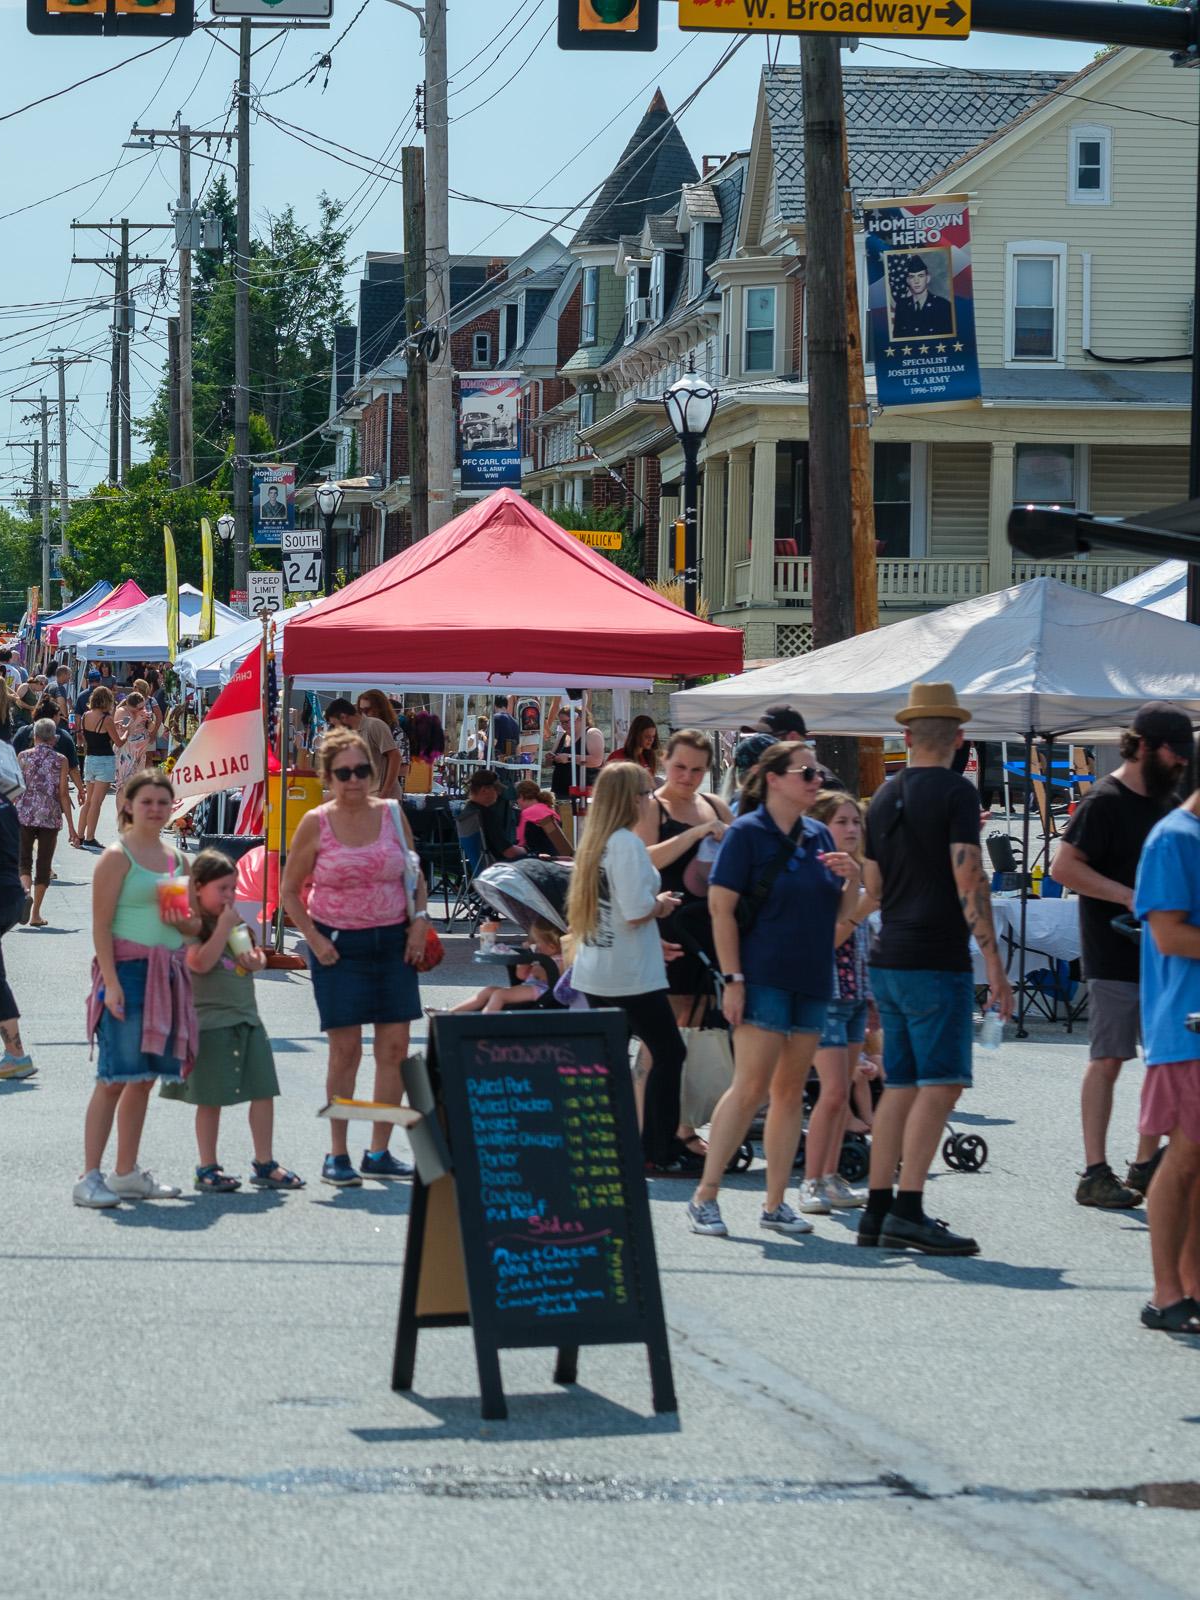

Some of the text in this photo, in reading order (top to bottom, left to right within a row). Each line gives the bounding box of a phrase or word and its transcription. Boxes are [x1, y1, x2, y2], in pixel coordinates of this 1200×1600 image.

[743, 0, 933, 31] W. Broadway
[868, 213, 964, 233] HOMETOWN
[891, 229, 942, 246] HERO
[902, 357, 948, 367] SPECIALIST
[887, 364, 965, 377] JOSEPH FOURHAM
[903, 375, 951, 386] U.S. ARMY
[285, 535, 319, 548] SOUTH
[579, 533, 613, 547] WALLICK
[288, 562, 318, 584] 24
[251, 576, 280, 585] SPEED
[254, 586, 276, 594] LIMIT
[252, 596, 280, 613] 25
[528, 1214, 585, 1235] Sides
